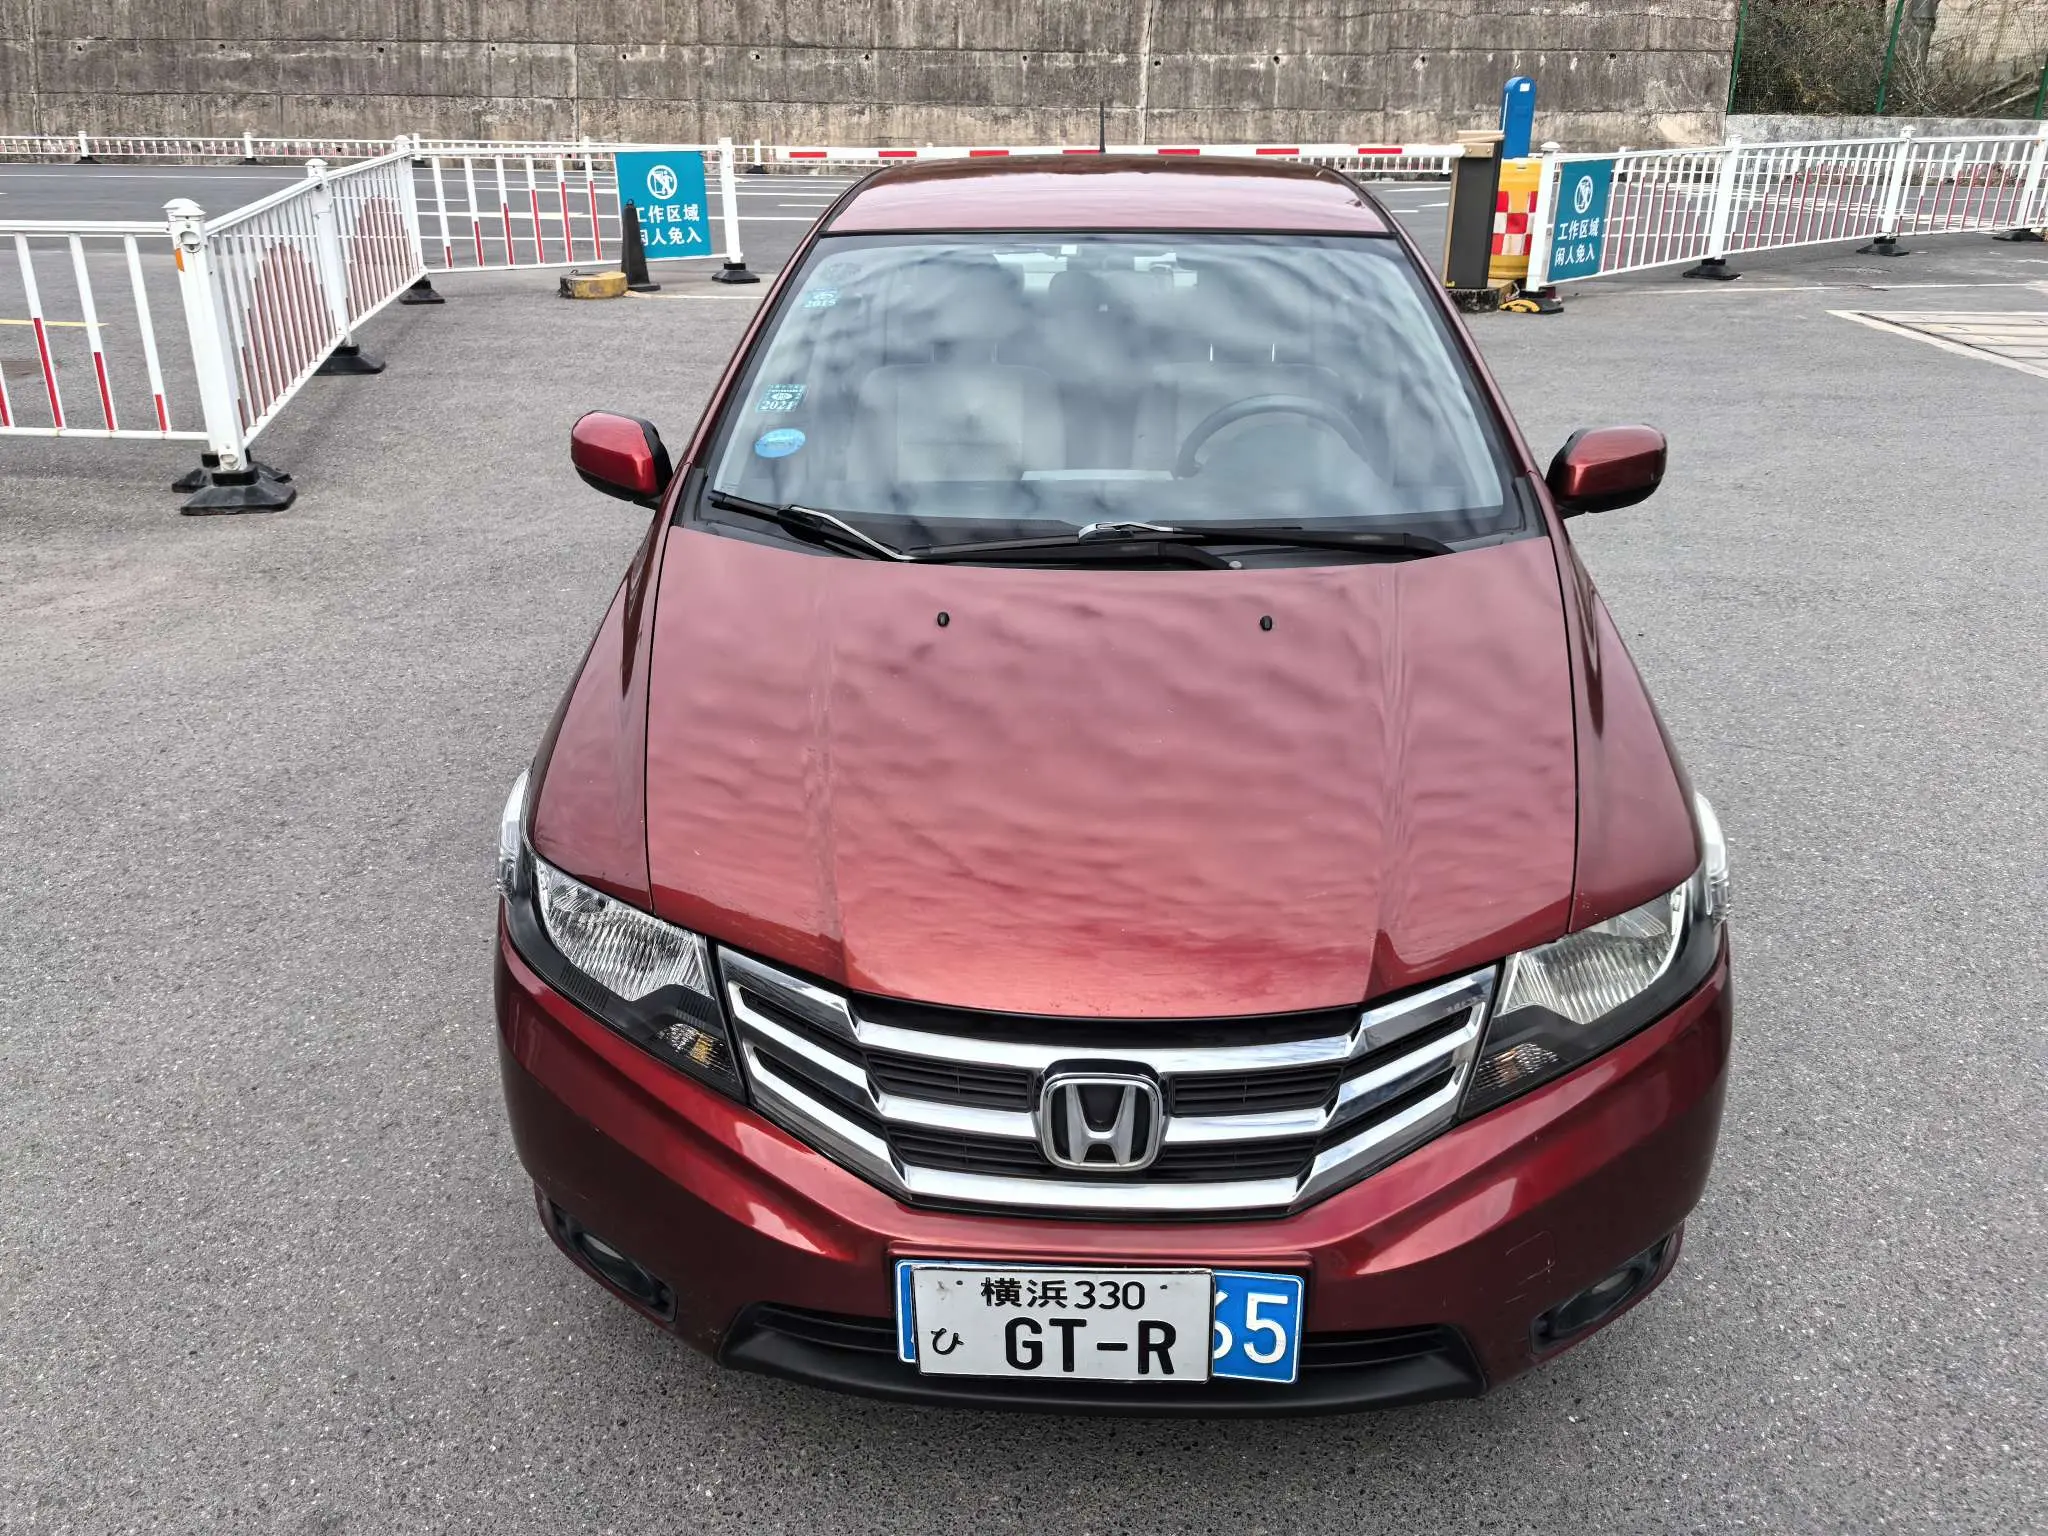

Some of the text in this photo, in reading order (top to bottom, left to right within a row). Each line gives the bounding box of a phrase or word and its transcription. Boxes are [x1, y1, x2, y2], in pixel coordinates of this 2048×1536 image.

[635, 204, 700, 223] 工作区域
[1557, 217, 1600, 241] 工作区域
[1554, 243, 1595, 267] 闲人免入
[981, 1276, 1146, 1311] 横浜330
[931, 1316, 1177, 1375] ひ GT-R
